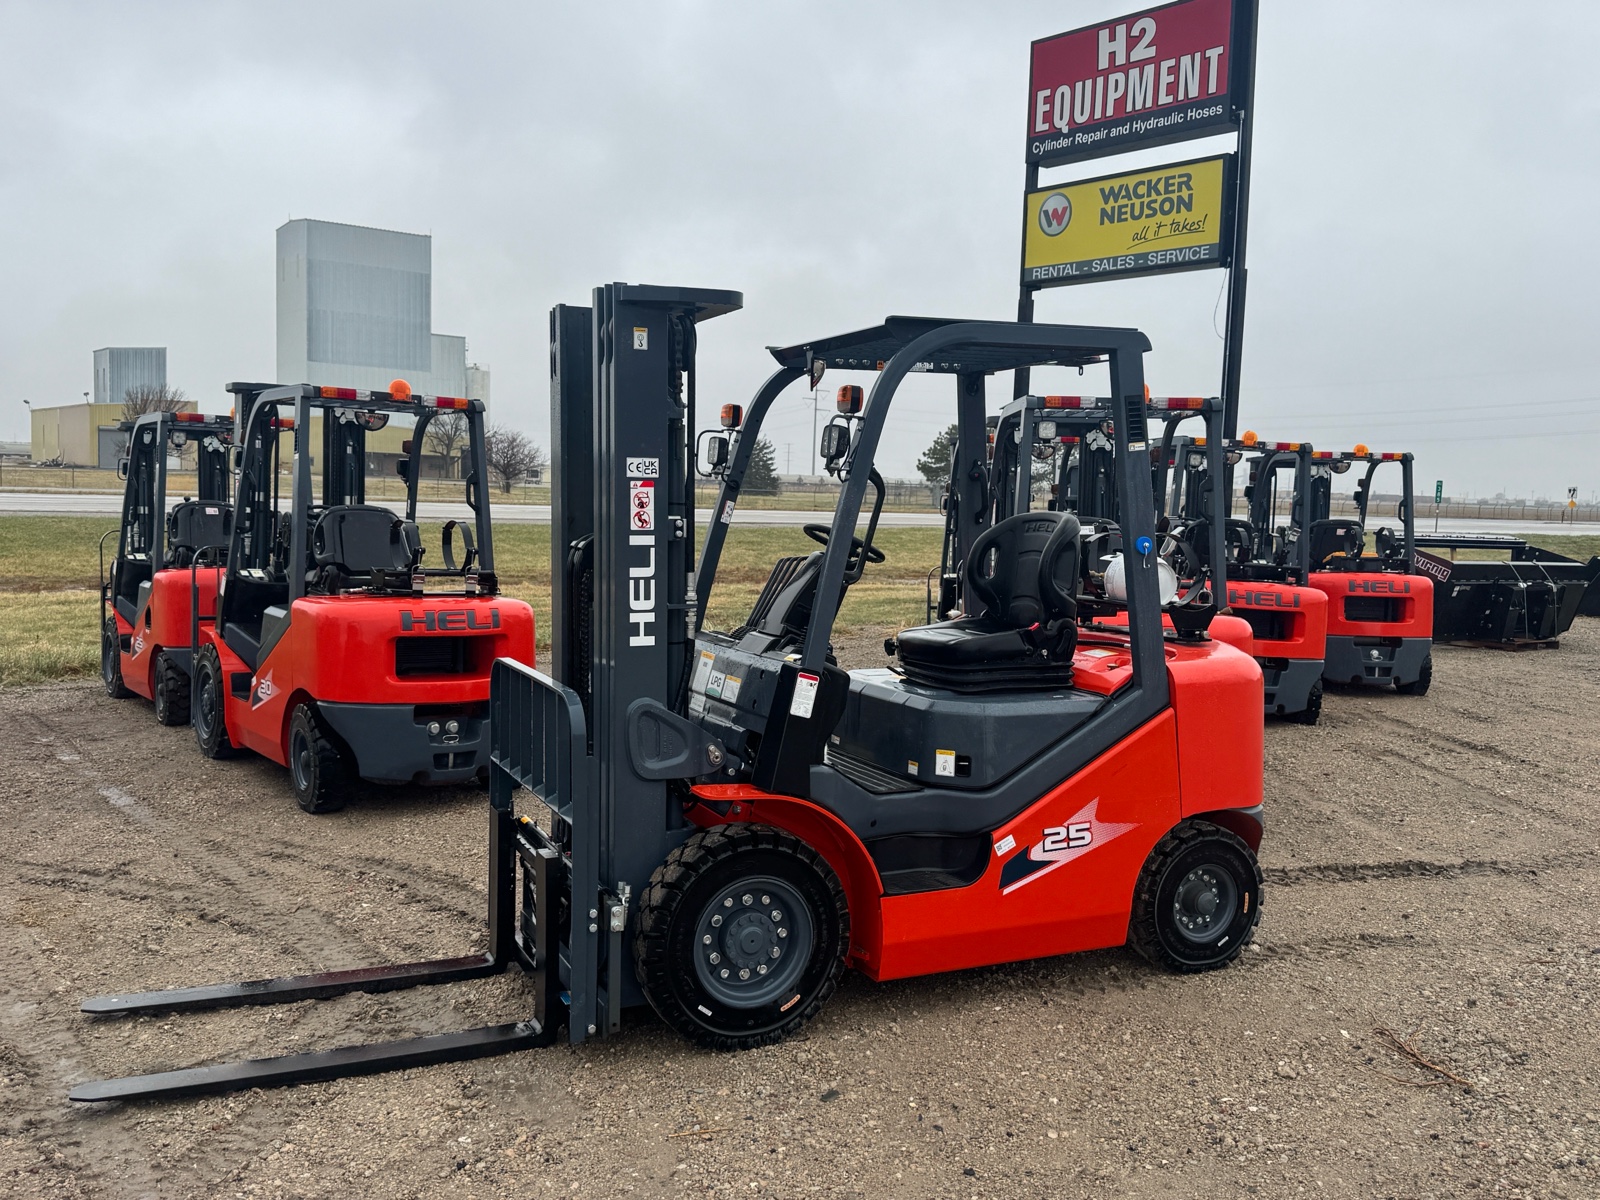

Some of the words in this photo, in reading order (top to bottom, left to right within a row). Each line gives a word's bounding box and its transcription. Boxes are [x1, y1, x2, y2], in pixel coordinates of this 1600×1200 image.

[1098, 17, 1157, 71] H2
[1034, 46, 1224, 134] EQUIPMENT
[1032, 137, 1072, 155] Cylinder
[1075, 128, 1108, 146] Repair
[1110, 123, 1130, 137] and
[1132, 112, 1184, 133] Hydraulic
[1187, 104, 1223, 121] Hoses
[1099, 172, 1194, 205] WACKER
[1099, 193, 1194, 226] NEUSON
[1132, 225, 1150, 242] all
[1154, 221, 1167, 237] it
[1169, 213, 1208, 234] takes!
[1032, 263, 1080, 280] RENTAL
[1091, 256, 1135, 273] SALES
[1147, 245, 1210, 266] SERVICE
[629, 535, 655, 647] HELI
[1229, 589, 1300, 608] HELI
[1349, 580, 1410, 594] HELI
[400, 608, 500, 632] HELI
[260, 678, 272, 696] 30
[711, 674, 722, 687] LPG
[1042, 821, 1093, 852] 25
